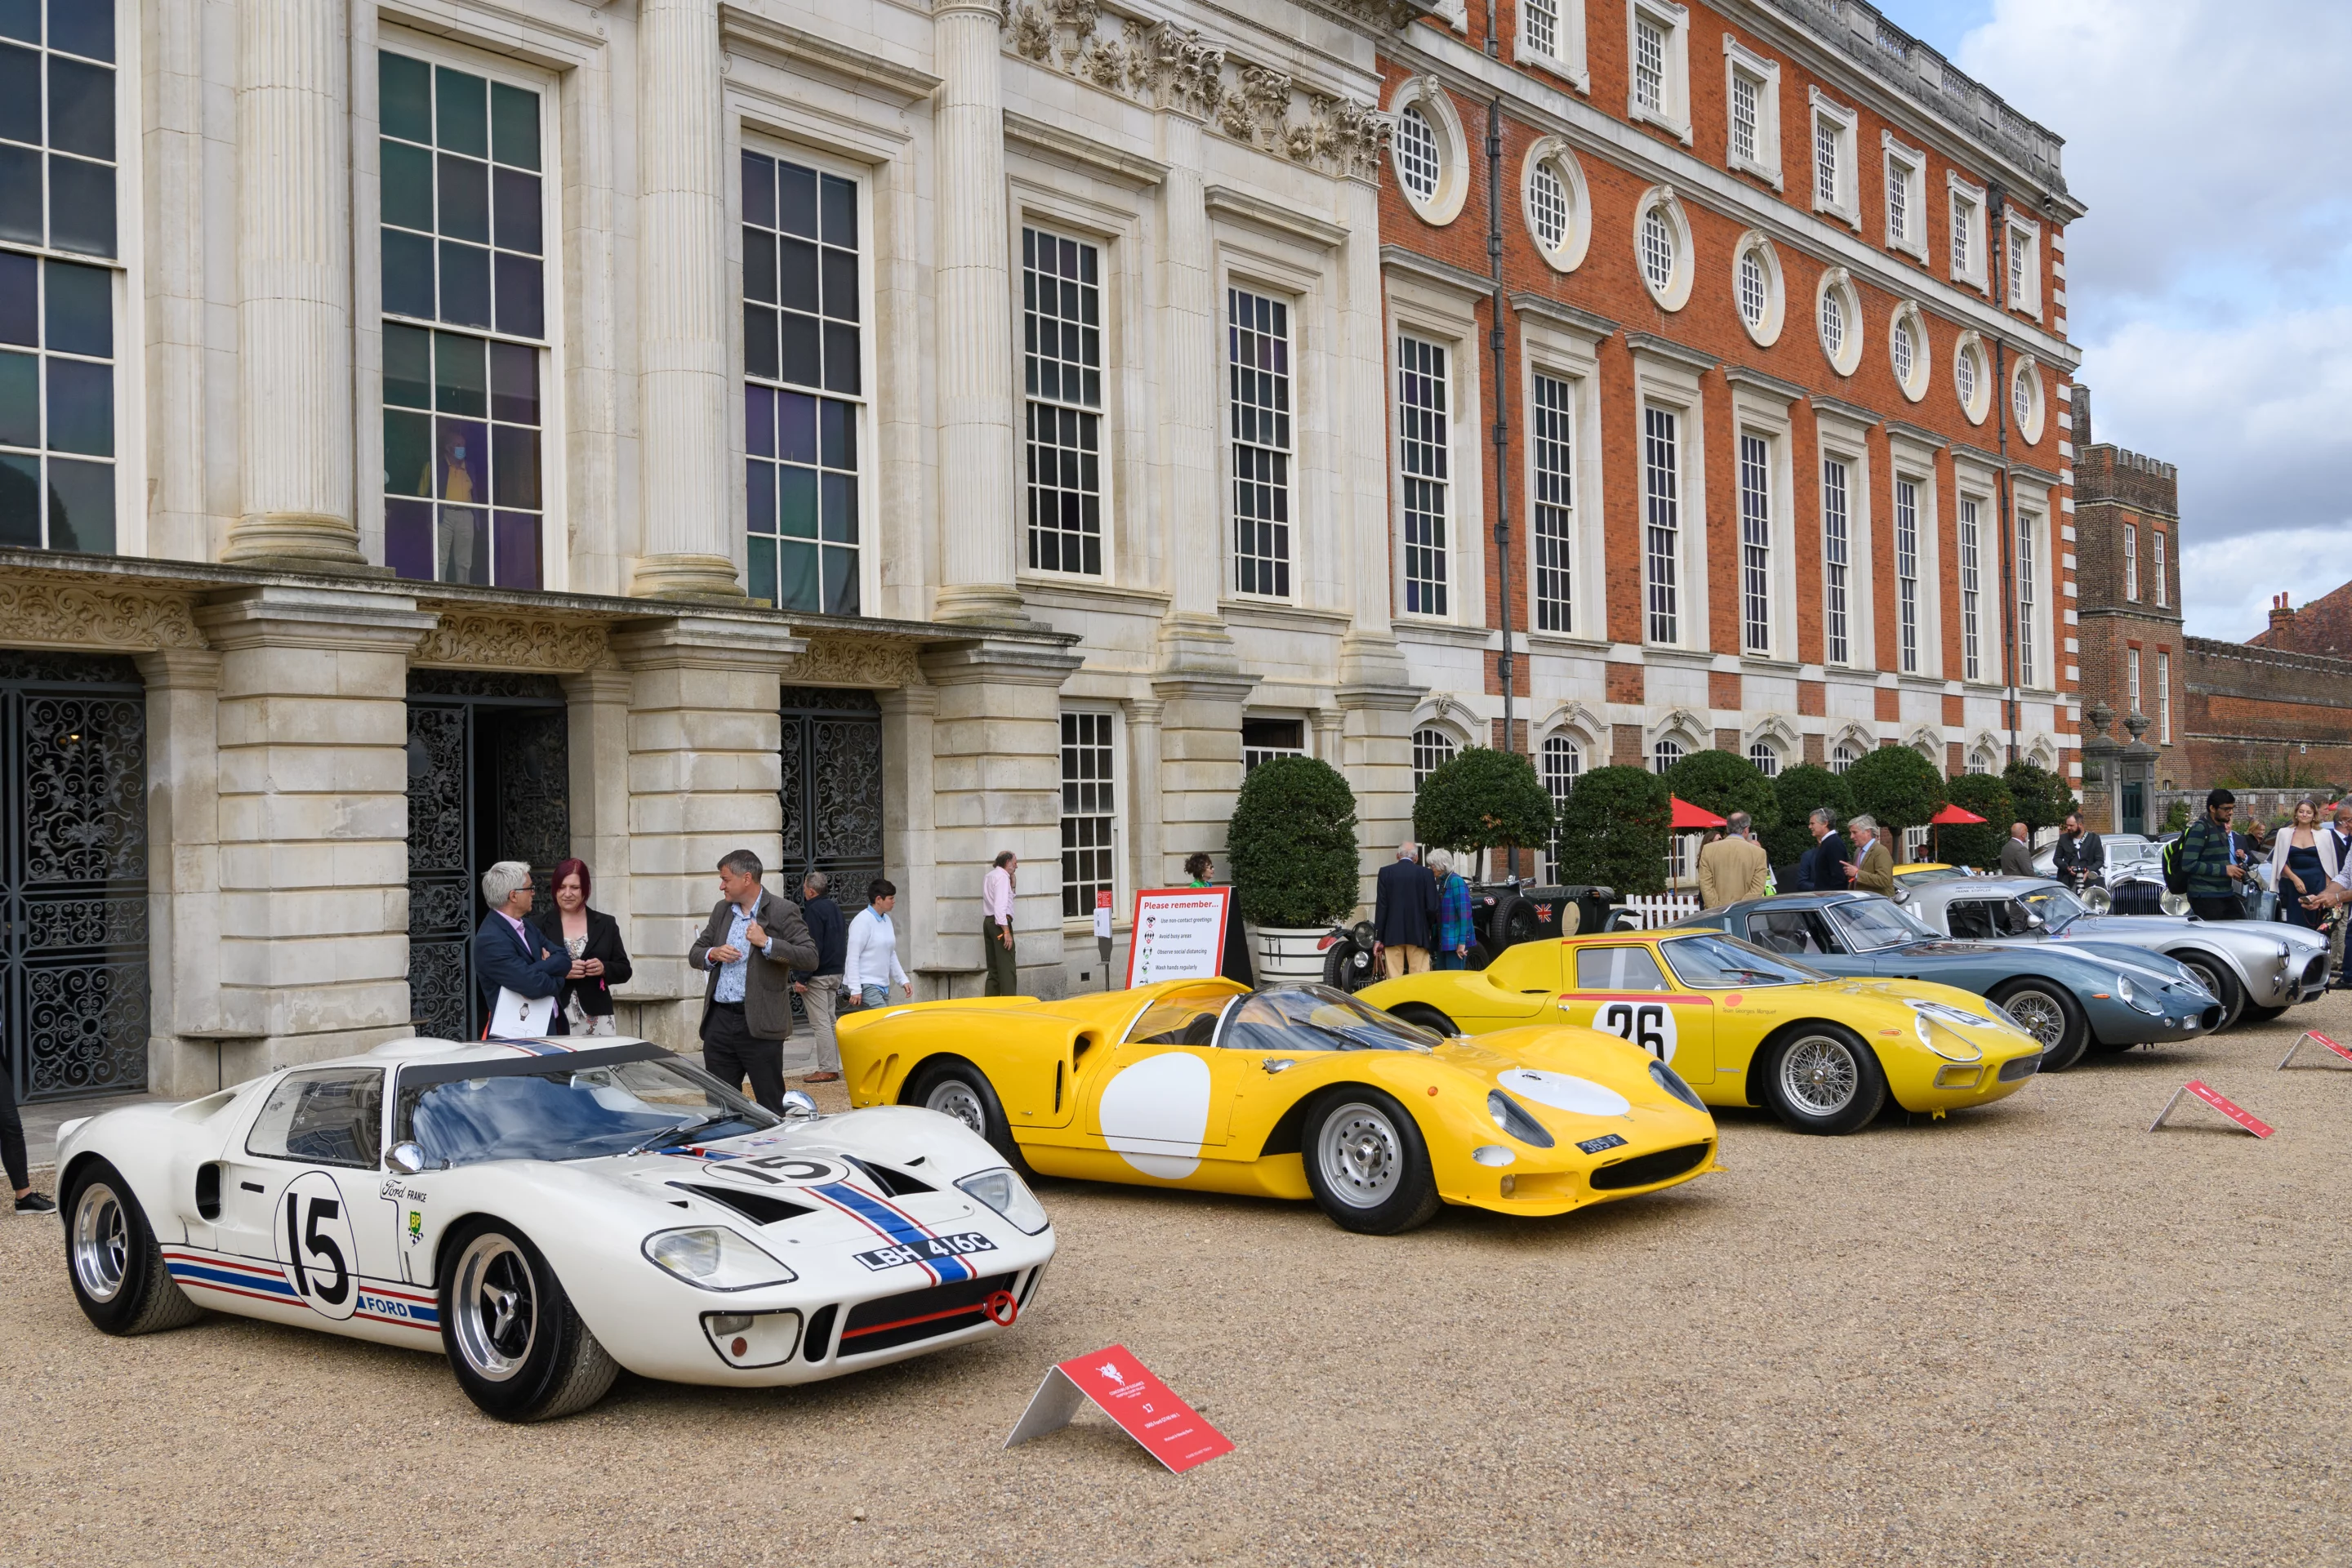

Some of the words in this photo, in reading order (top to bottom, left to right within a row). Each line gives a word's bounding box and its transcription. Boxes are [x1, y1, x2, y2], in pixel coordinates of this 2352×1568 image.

[1171, 900, 1218, 908] remember...
[1607, 1004, 1664, 1062] 26
[1581, 1138, 1610, 1152] 365
[1606, 1135, 1619, 1146] P
[713, 1155, 831, 1184] 15
[381, 1179, 405, 1198] Ford
[408, 1190, 426, 1203] FRANCE
[411, 1214, 421, 1228] BP
[287, 1192, 349, 1305] 15
[856, 1244, 921, 1271] LBH
[928, 1231, 994, 1257] 416C
[367, 1297, 408, 1317] FORD
[1143, 1403, 1154, 1413] 17
